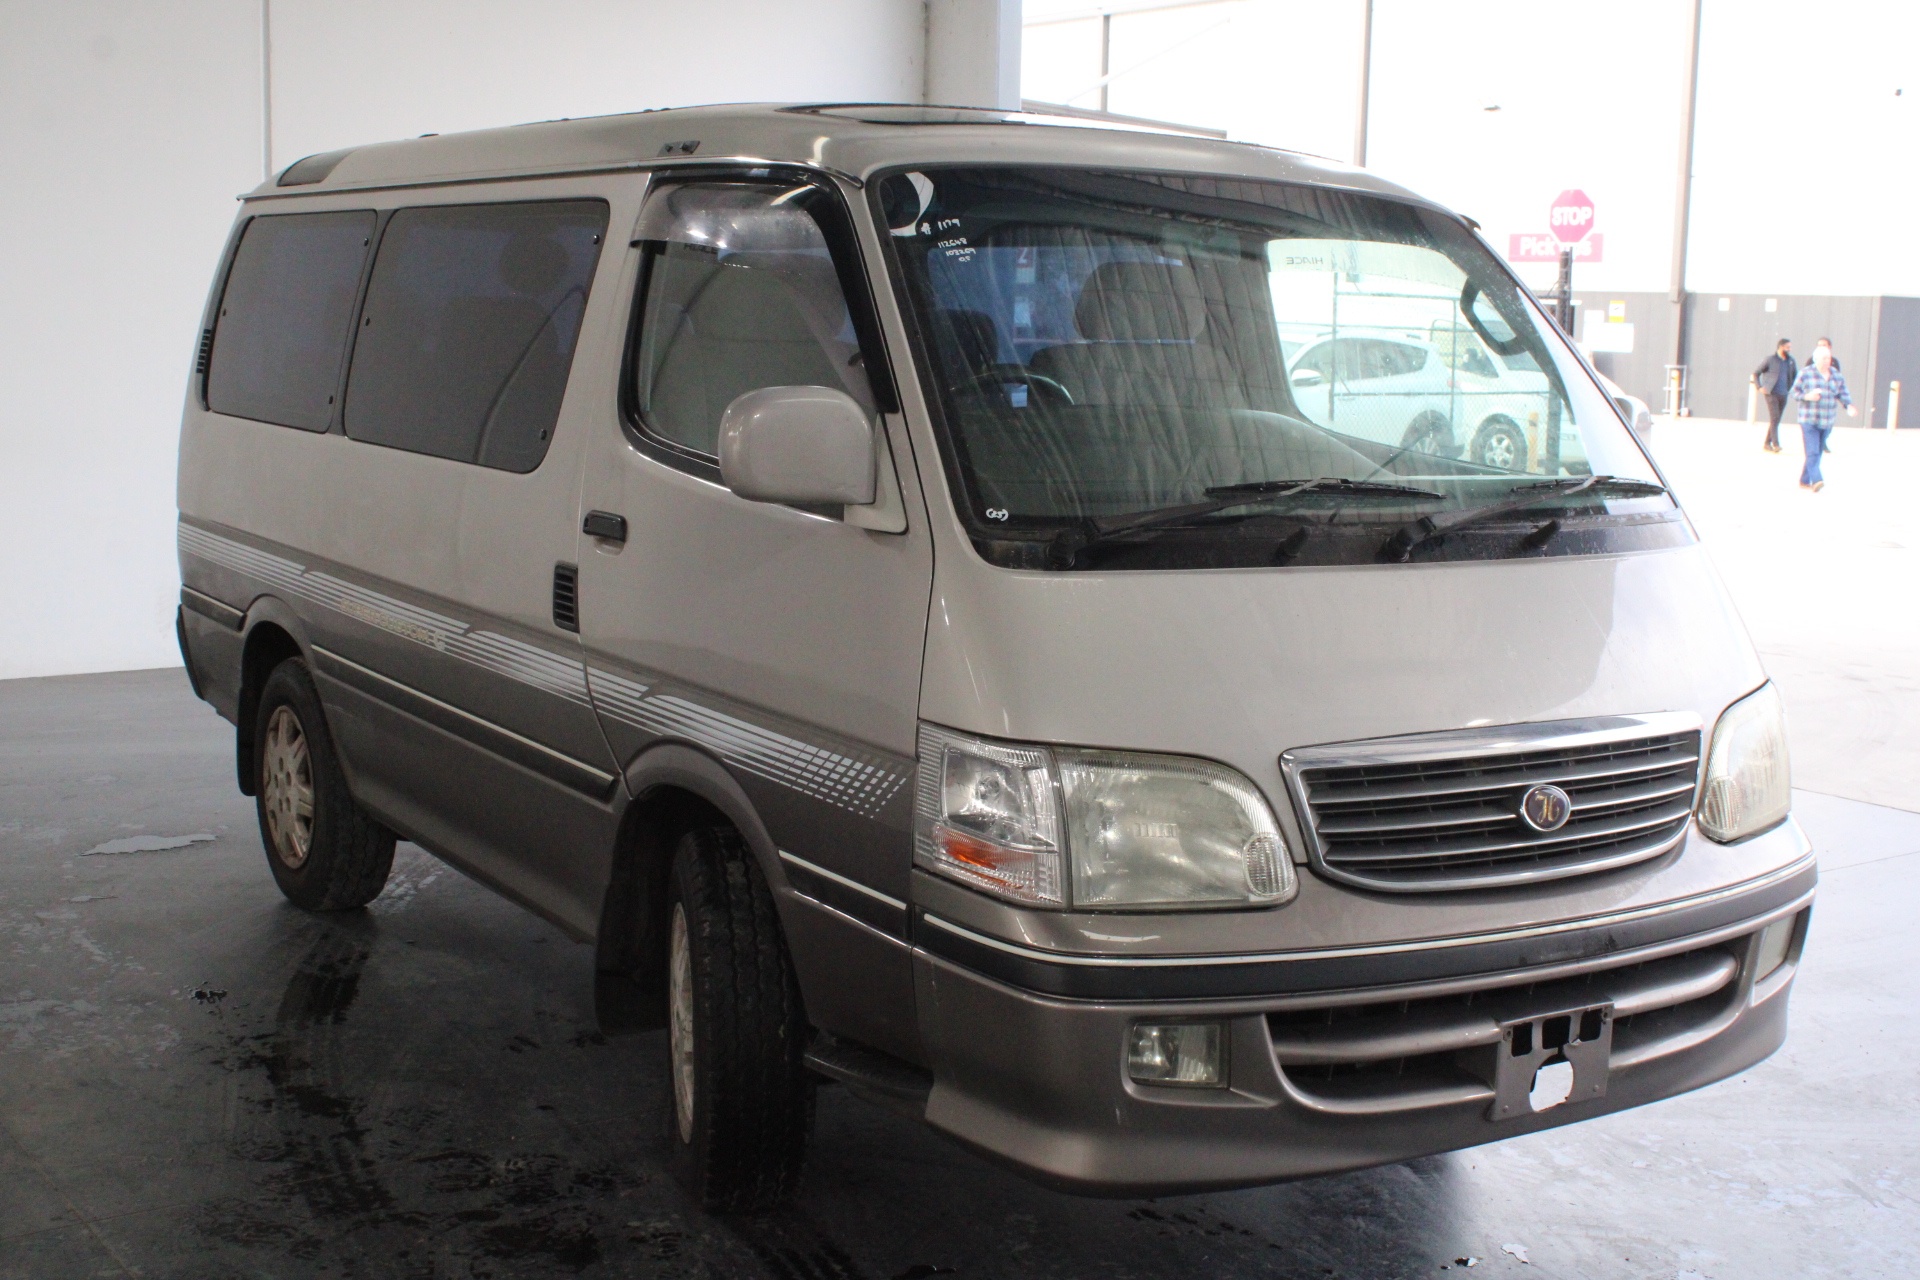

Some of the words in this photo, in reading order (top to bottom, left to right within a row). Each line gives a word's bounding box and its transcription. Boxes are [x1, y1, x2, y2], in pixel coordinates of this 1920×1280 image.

[1552, 206, 1592, 226] STOP
[1520, 236, 1556, 256] Pick
[340, 598, 379, 624] SUPER
[379, 613, 430, 643] CUSTOM
